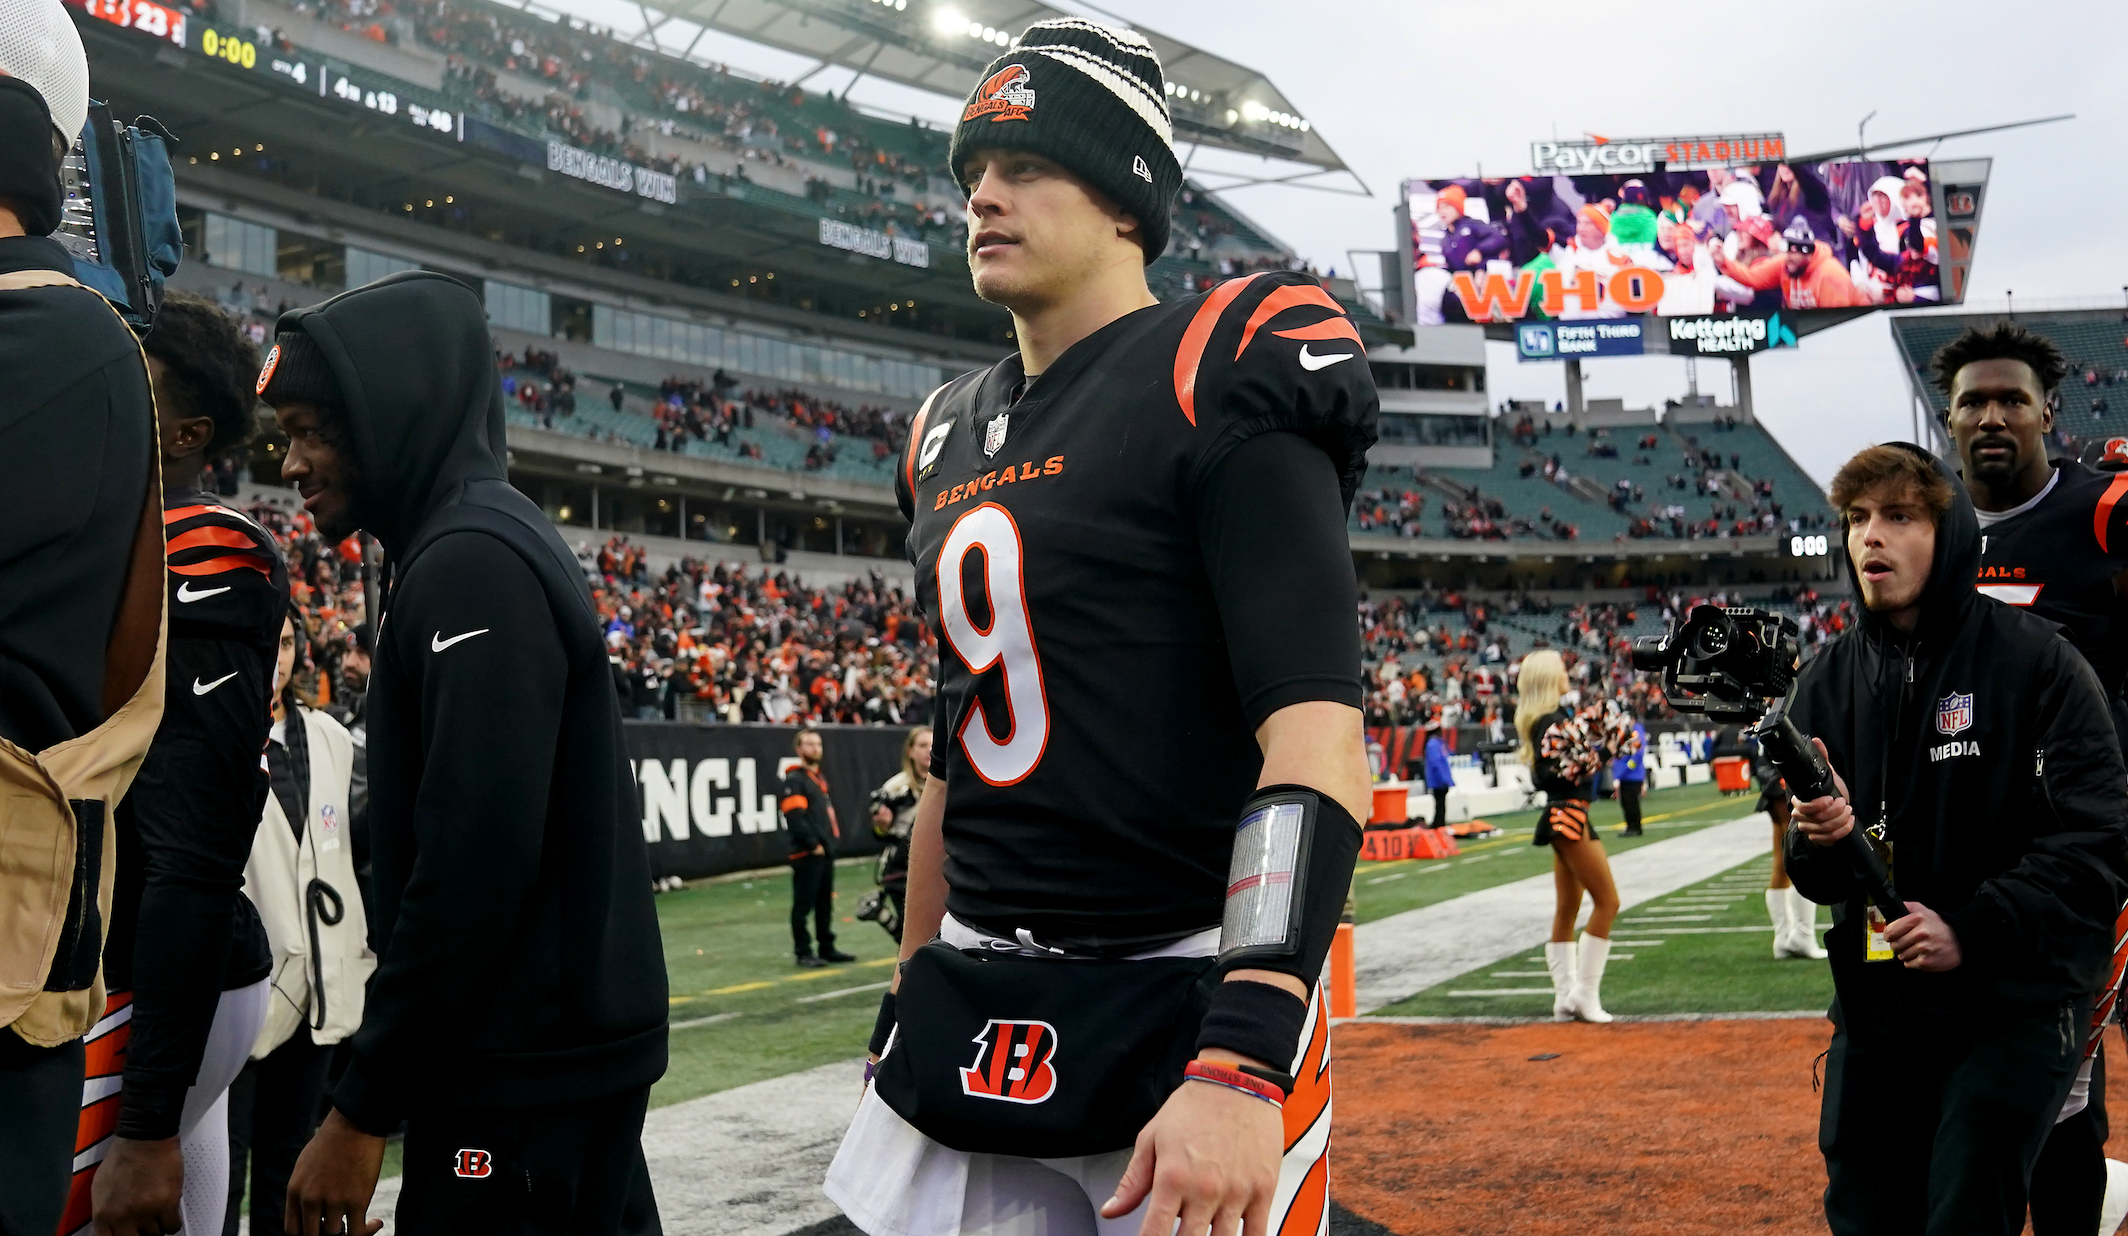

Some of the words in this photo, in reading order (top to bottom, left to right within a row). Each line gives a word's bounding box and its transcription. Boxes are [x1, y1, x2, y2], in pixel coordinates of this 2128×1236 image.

[135, 1, 168, 36] 23
[202, 28, 256, 69] 0:00
[547, 140, 634, 192] BENGALS
[634, 166, 677, 204] WIN
[1533, 143, 1660, 172] Paycor
[1665, 138, 1784, 163] STADIUM
[819, 217, 892, 260] BENGALS
[1452, 267, 1665, 320] WHO
[1597, 324, 1641, 338] THIRD
[1670, 315, 1766, 341] Kettering
[1697, 337, 1755, 352] HEALTH
[934, 455, 1065, 512] BENGALS
[935, 501, 1050, 787] 9
[1940, 709, 1968, 729] NFL
[1929, 740, 1981, 762] MEDIA
[1200, 1064, 1241, 1083] STRONG
[1244, 1076, 1265, 1091] ONE
